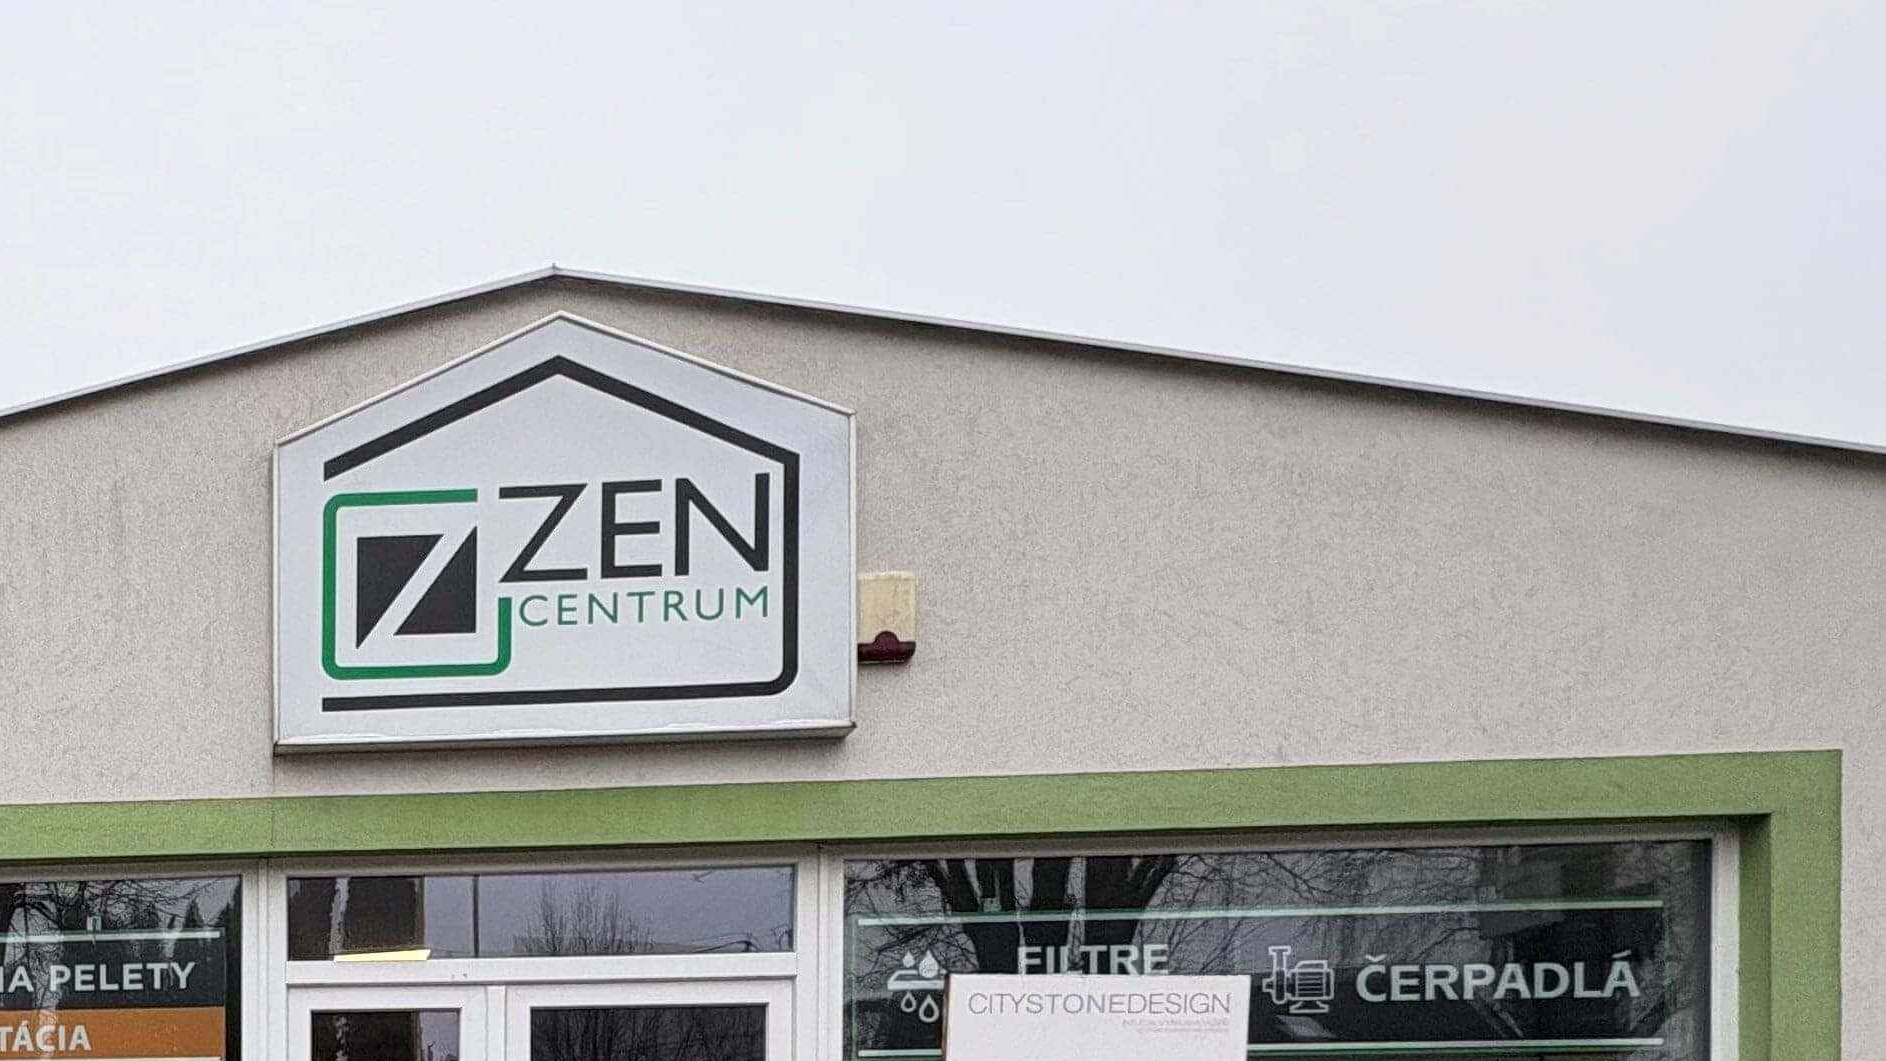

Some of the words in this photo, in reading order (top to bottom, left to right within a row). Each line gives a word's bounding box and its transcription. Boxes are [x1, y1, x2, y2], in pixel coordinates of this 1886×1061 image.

[498, 472, 770, 583] ZEN
[518, 585, 769, 627] CENTRUM
[49, 961, 196, 992] PELETY
[1018, 944, 1170, 975] FILTRE
[1356, 950, 1641, 1002] ČERPADLÁ
[968, 992, 1233, 1015] CITYSTONEDESIGN
